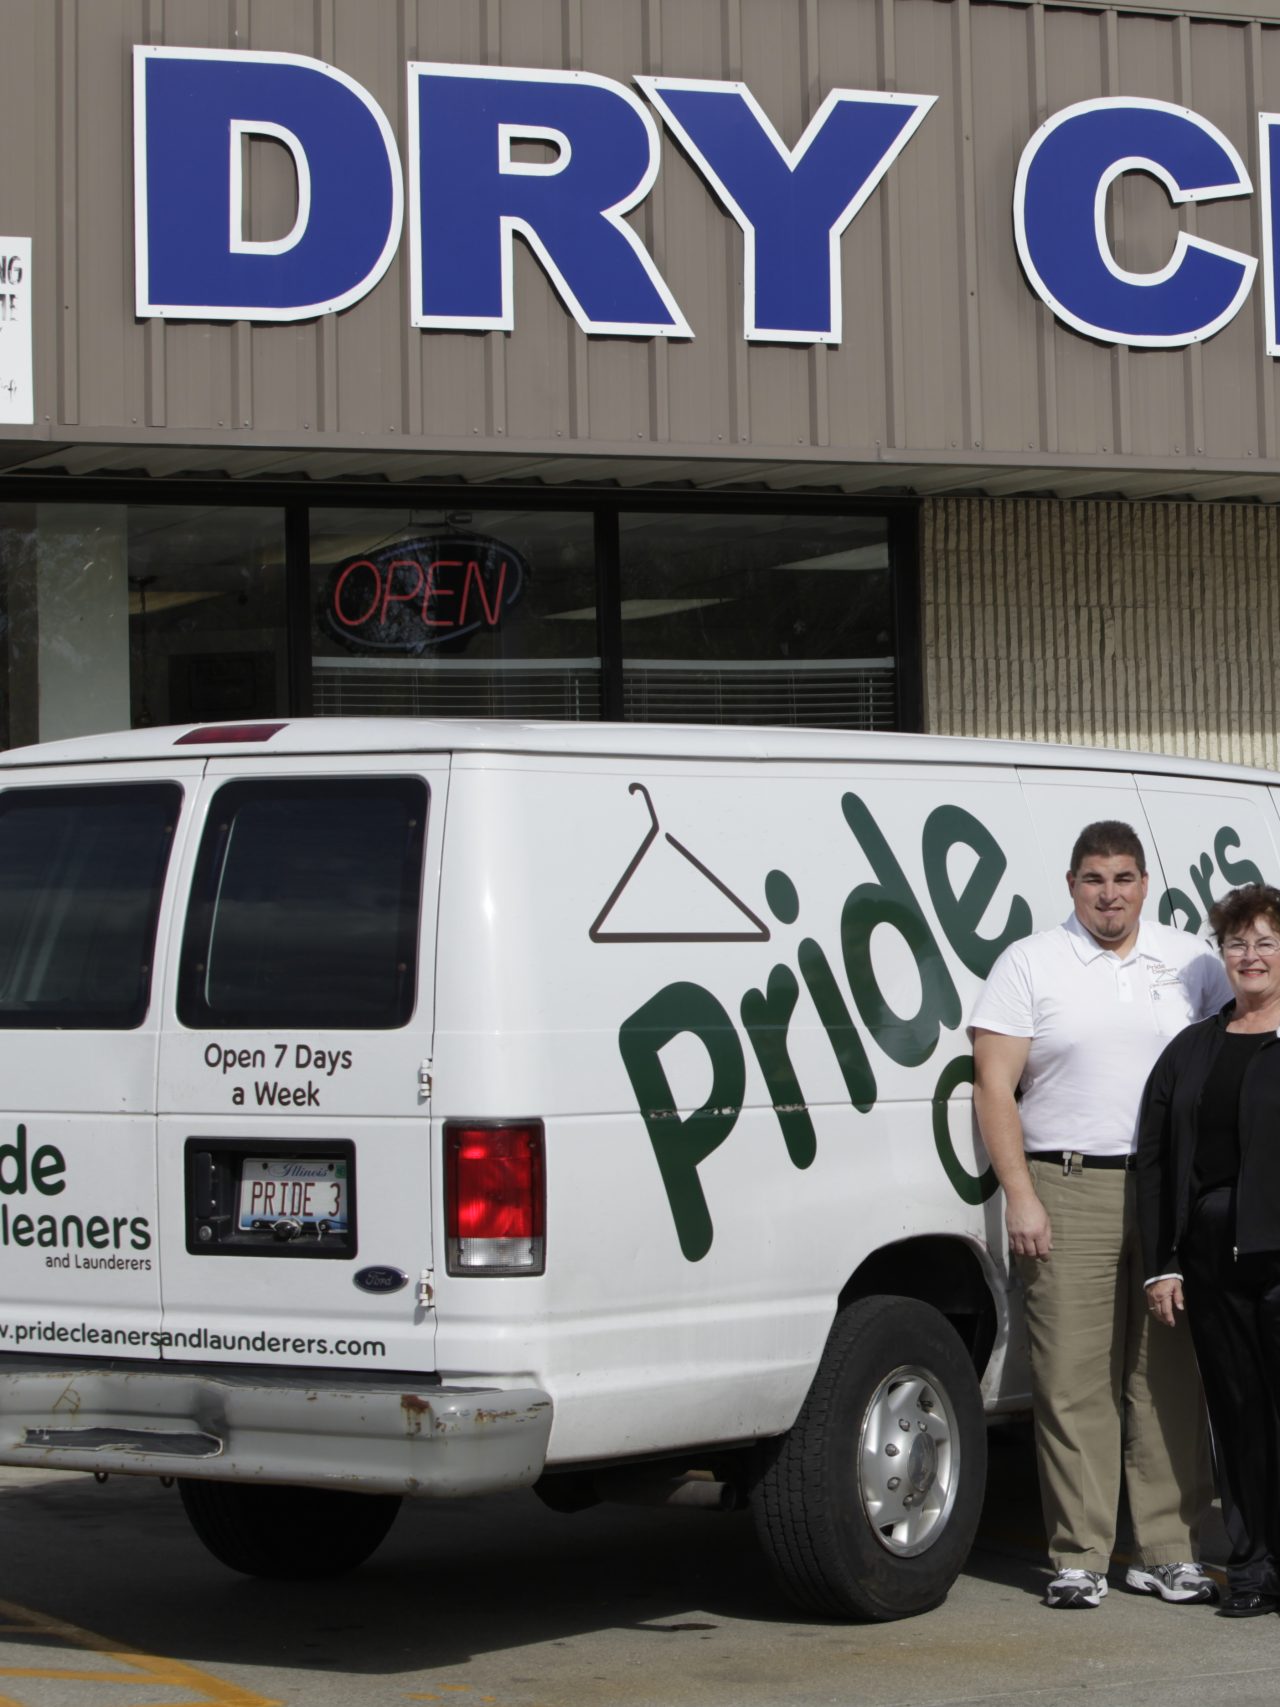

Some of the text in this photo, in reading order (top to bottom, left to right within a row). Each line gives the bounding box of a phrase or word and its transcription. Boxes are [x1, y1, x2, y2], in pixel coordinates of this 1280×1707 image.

[133, 45, 938, 345] DRY
[335, 560, 507, 625] OPEN
[618, 791, 1032, 1263] Pride
[204, 1043, 353, 1076] Open 7 Days
[232, 1080, 320, 1107] a Week
[269, 1163, 329, 1178] Illinois
[250, 1181, 341, 1217] PRIDE 3
[45, 1253, 152, 1271] and Launderers
